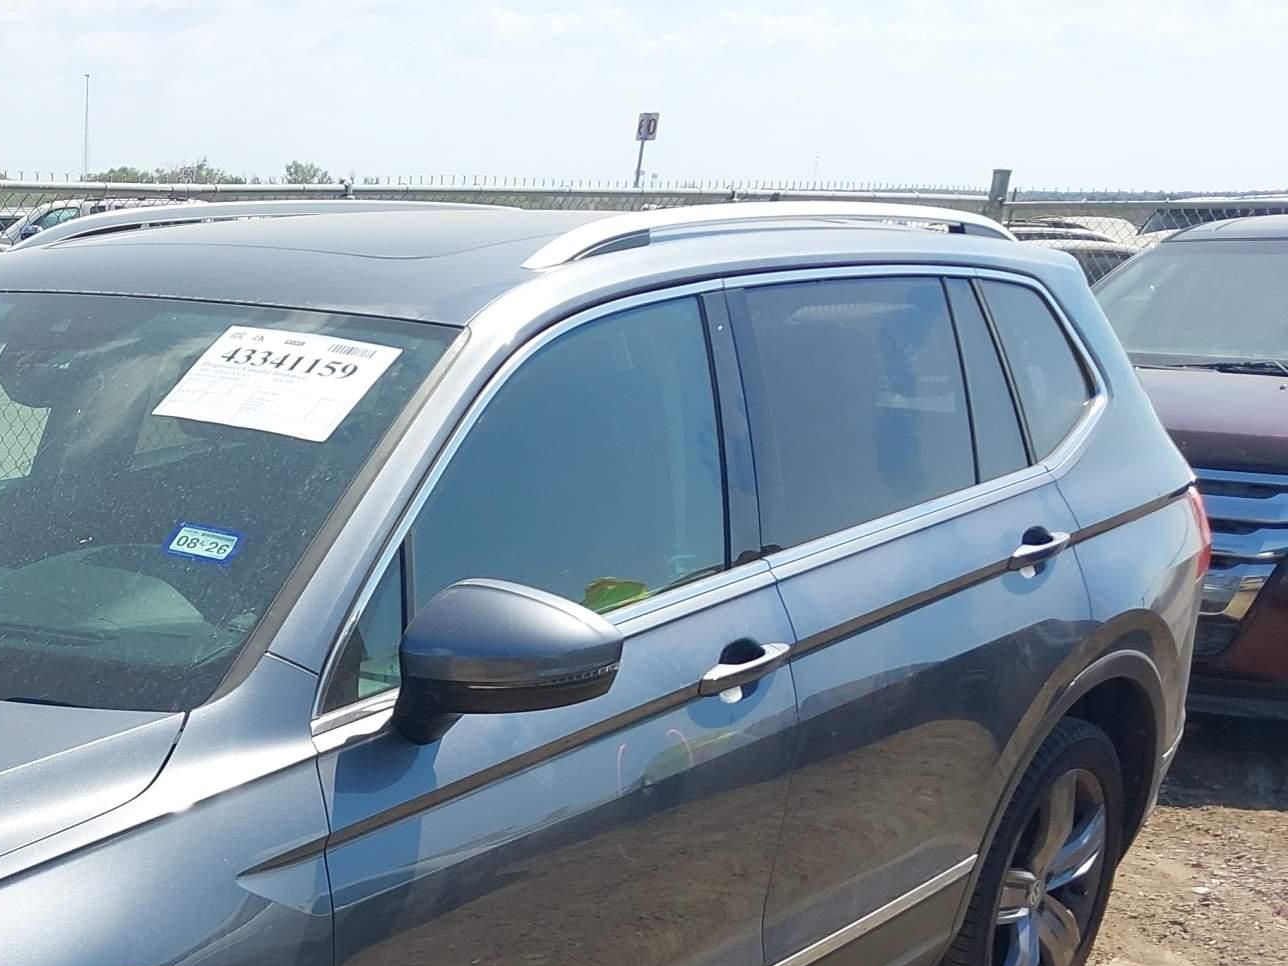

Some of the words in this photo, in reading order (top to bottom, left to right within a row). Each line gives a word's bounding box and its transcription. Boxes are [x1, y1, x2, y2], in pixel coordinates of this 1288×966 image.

[221, 346, 359, 380] 43341159
[176, 535, 200, 549] 08
[204, 541, 230, 555] 26
